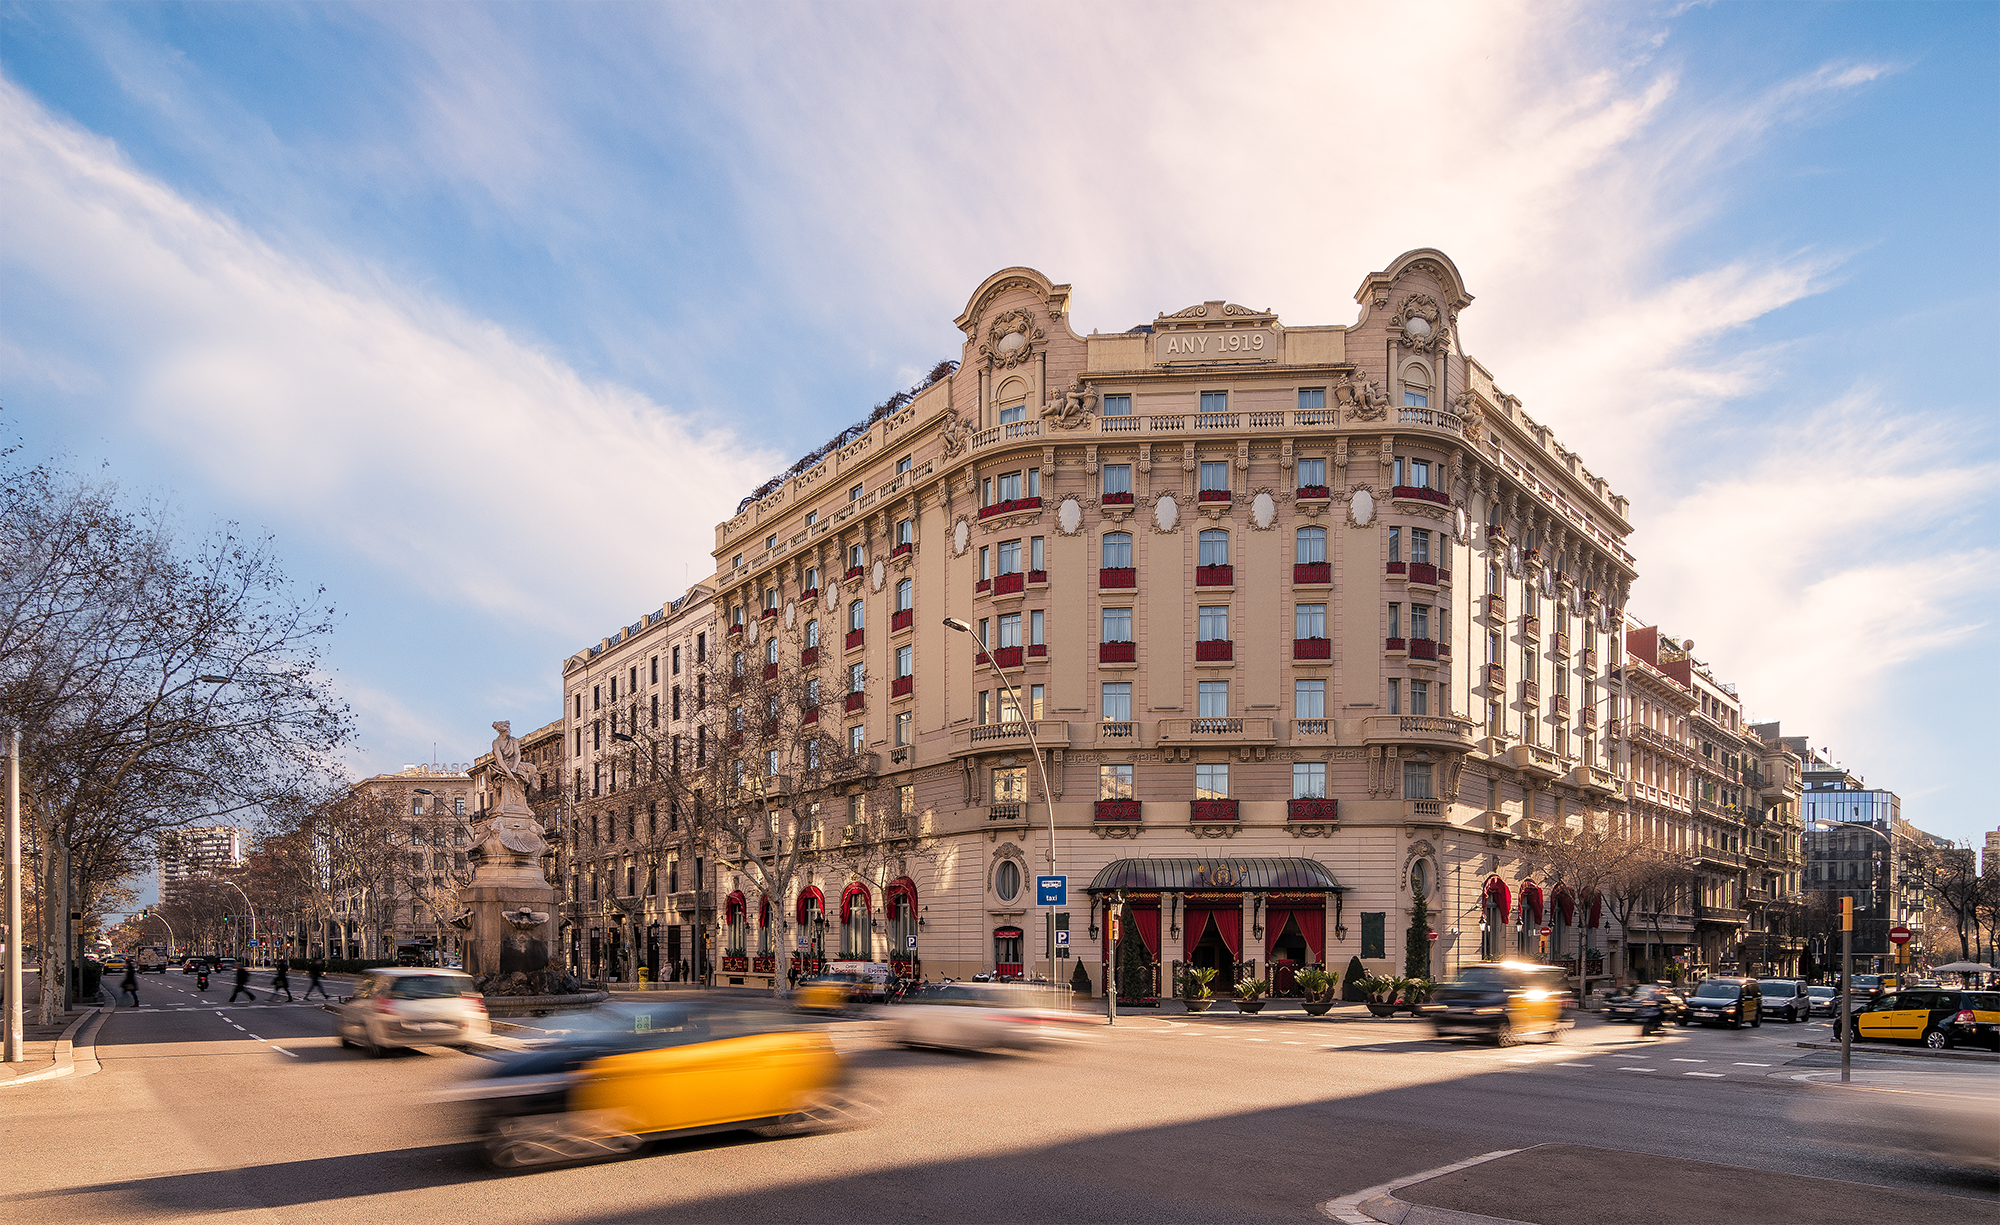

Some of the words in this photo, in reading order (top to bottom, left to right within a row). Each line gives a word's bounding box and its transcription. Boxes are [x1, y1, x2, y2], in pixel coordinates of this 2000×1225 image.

[1167, 336, 1209, 354] ANY
[1218, 334, 1264, 352] 1919
[420, 763, 471, 774] OCASO
[908, 937, 915, 946] P
[1058, 932, 1067, 943] P
